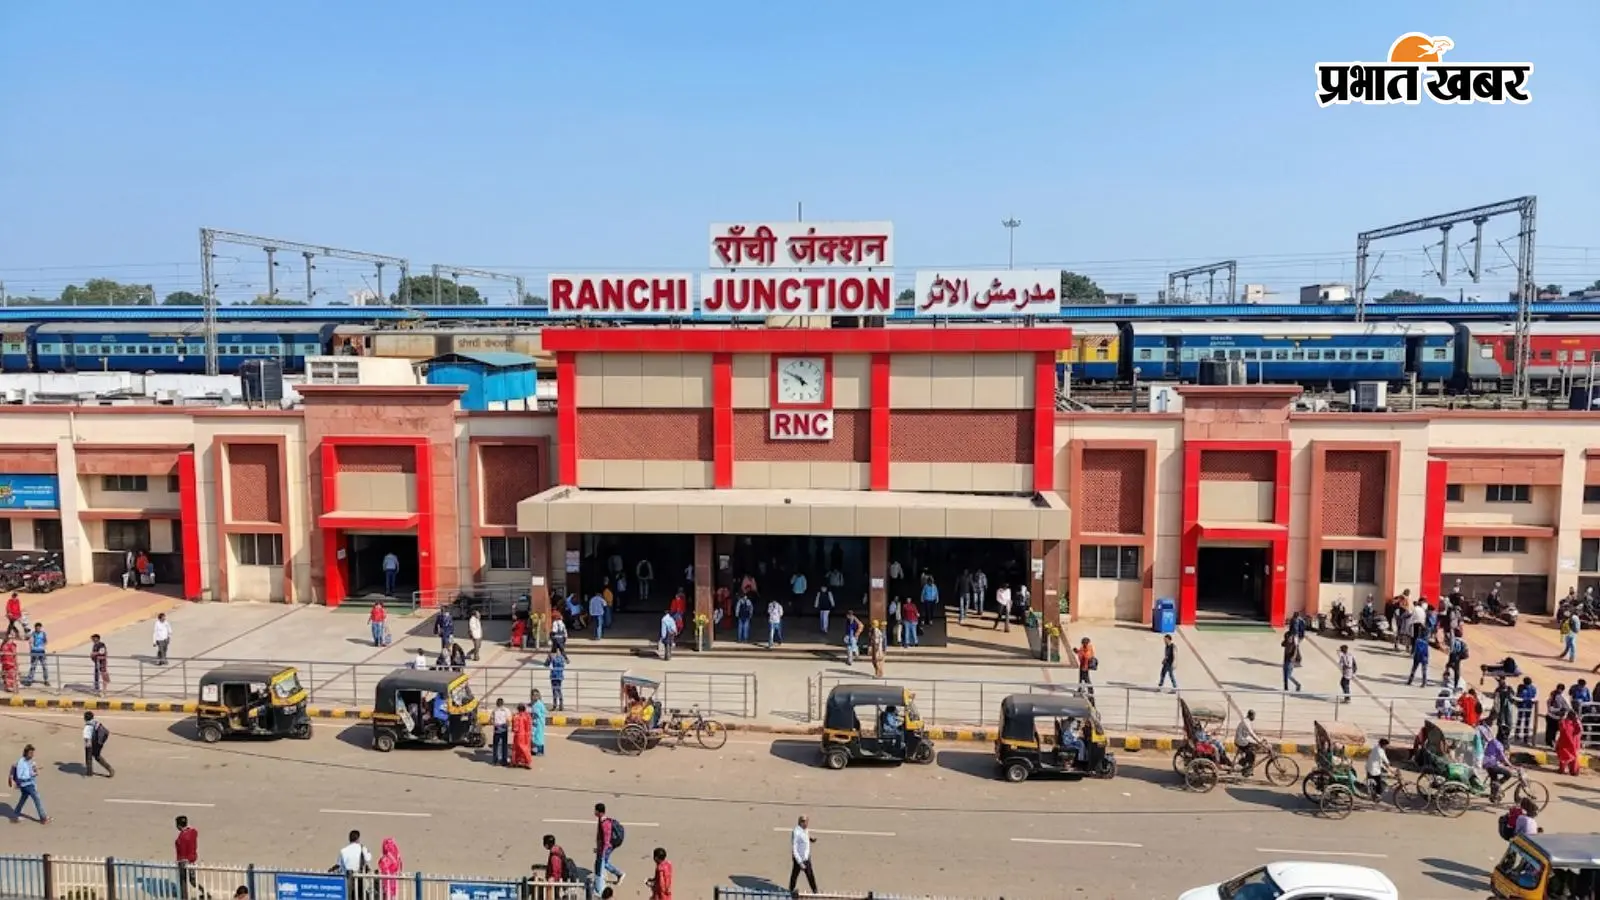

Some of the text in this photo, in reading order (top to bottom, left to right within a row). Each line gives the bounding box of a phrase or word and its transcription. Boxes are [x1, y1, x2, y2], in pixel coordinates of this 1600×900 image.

[714, 226, 887, 263] राँची जंक्शन
[552, 278, 890, 310] RANCHI JUNCTION
[775, 413, 828, 436] RNC
